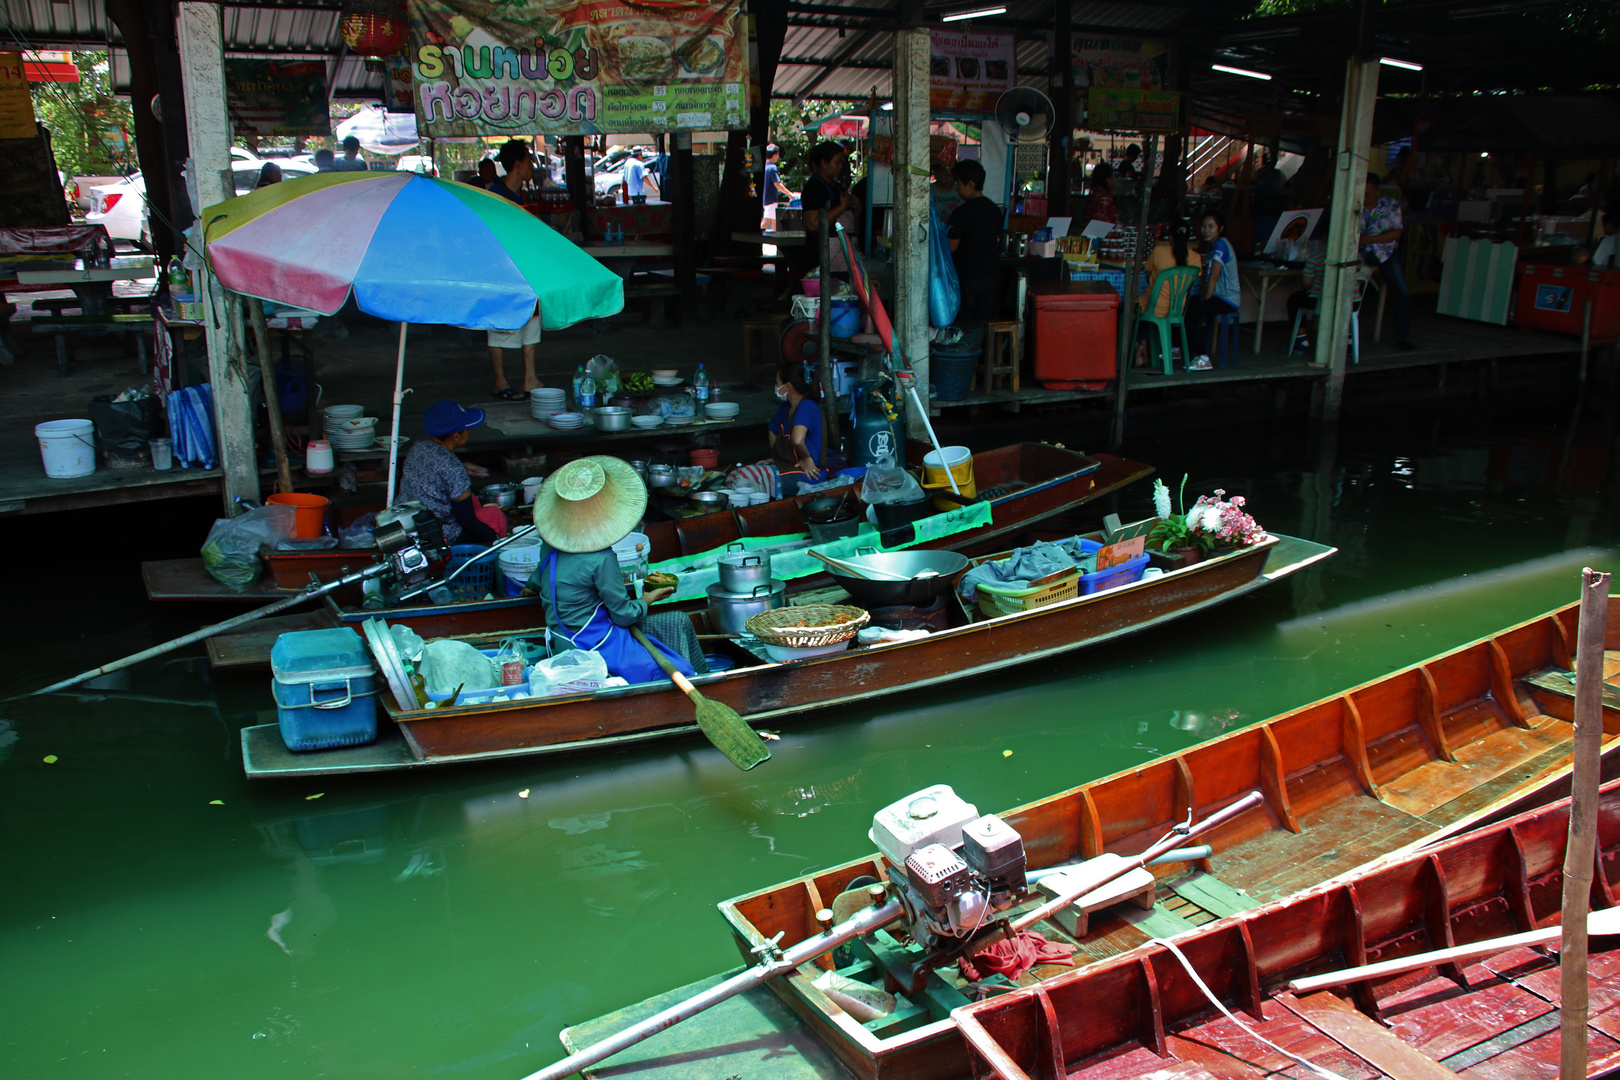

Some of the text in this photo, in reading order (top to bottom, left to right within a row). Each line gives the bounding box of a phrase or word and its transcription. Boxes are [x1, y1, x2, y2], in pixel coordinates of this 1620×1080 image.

[418, 31, 599, 80] ร้านหน่อย
[419, 81, 598, 123] หอยทอด
